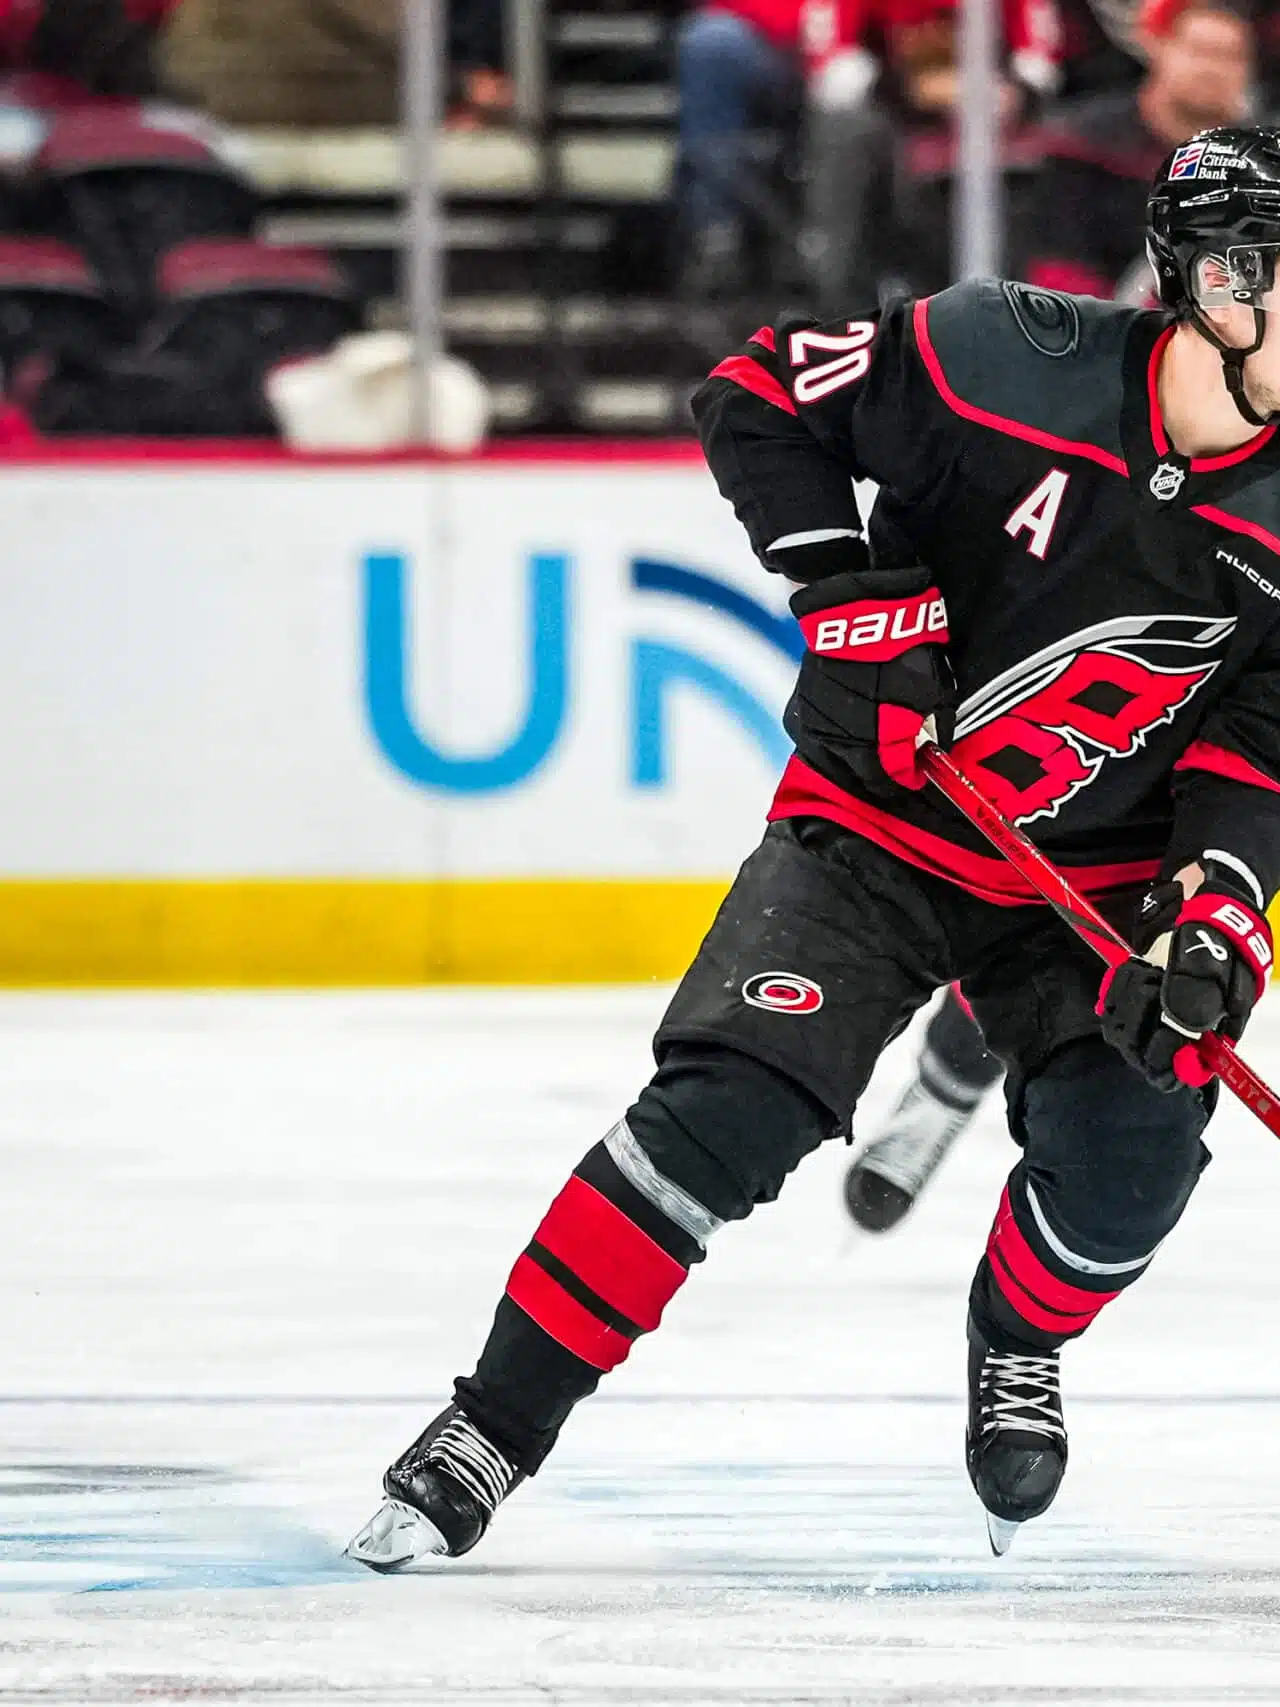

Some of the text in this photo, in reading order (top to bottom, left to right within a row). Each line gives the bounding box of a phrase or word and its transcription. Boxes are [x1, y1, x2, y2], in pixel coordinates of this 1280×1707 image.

[1198, 167, 1228, 180] Bank
[789, 320, 878, 405] 20
[1002, 466, 1071, 560] A
